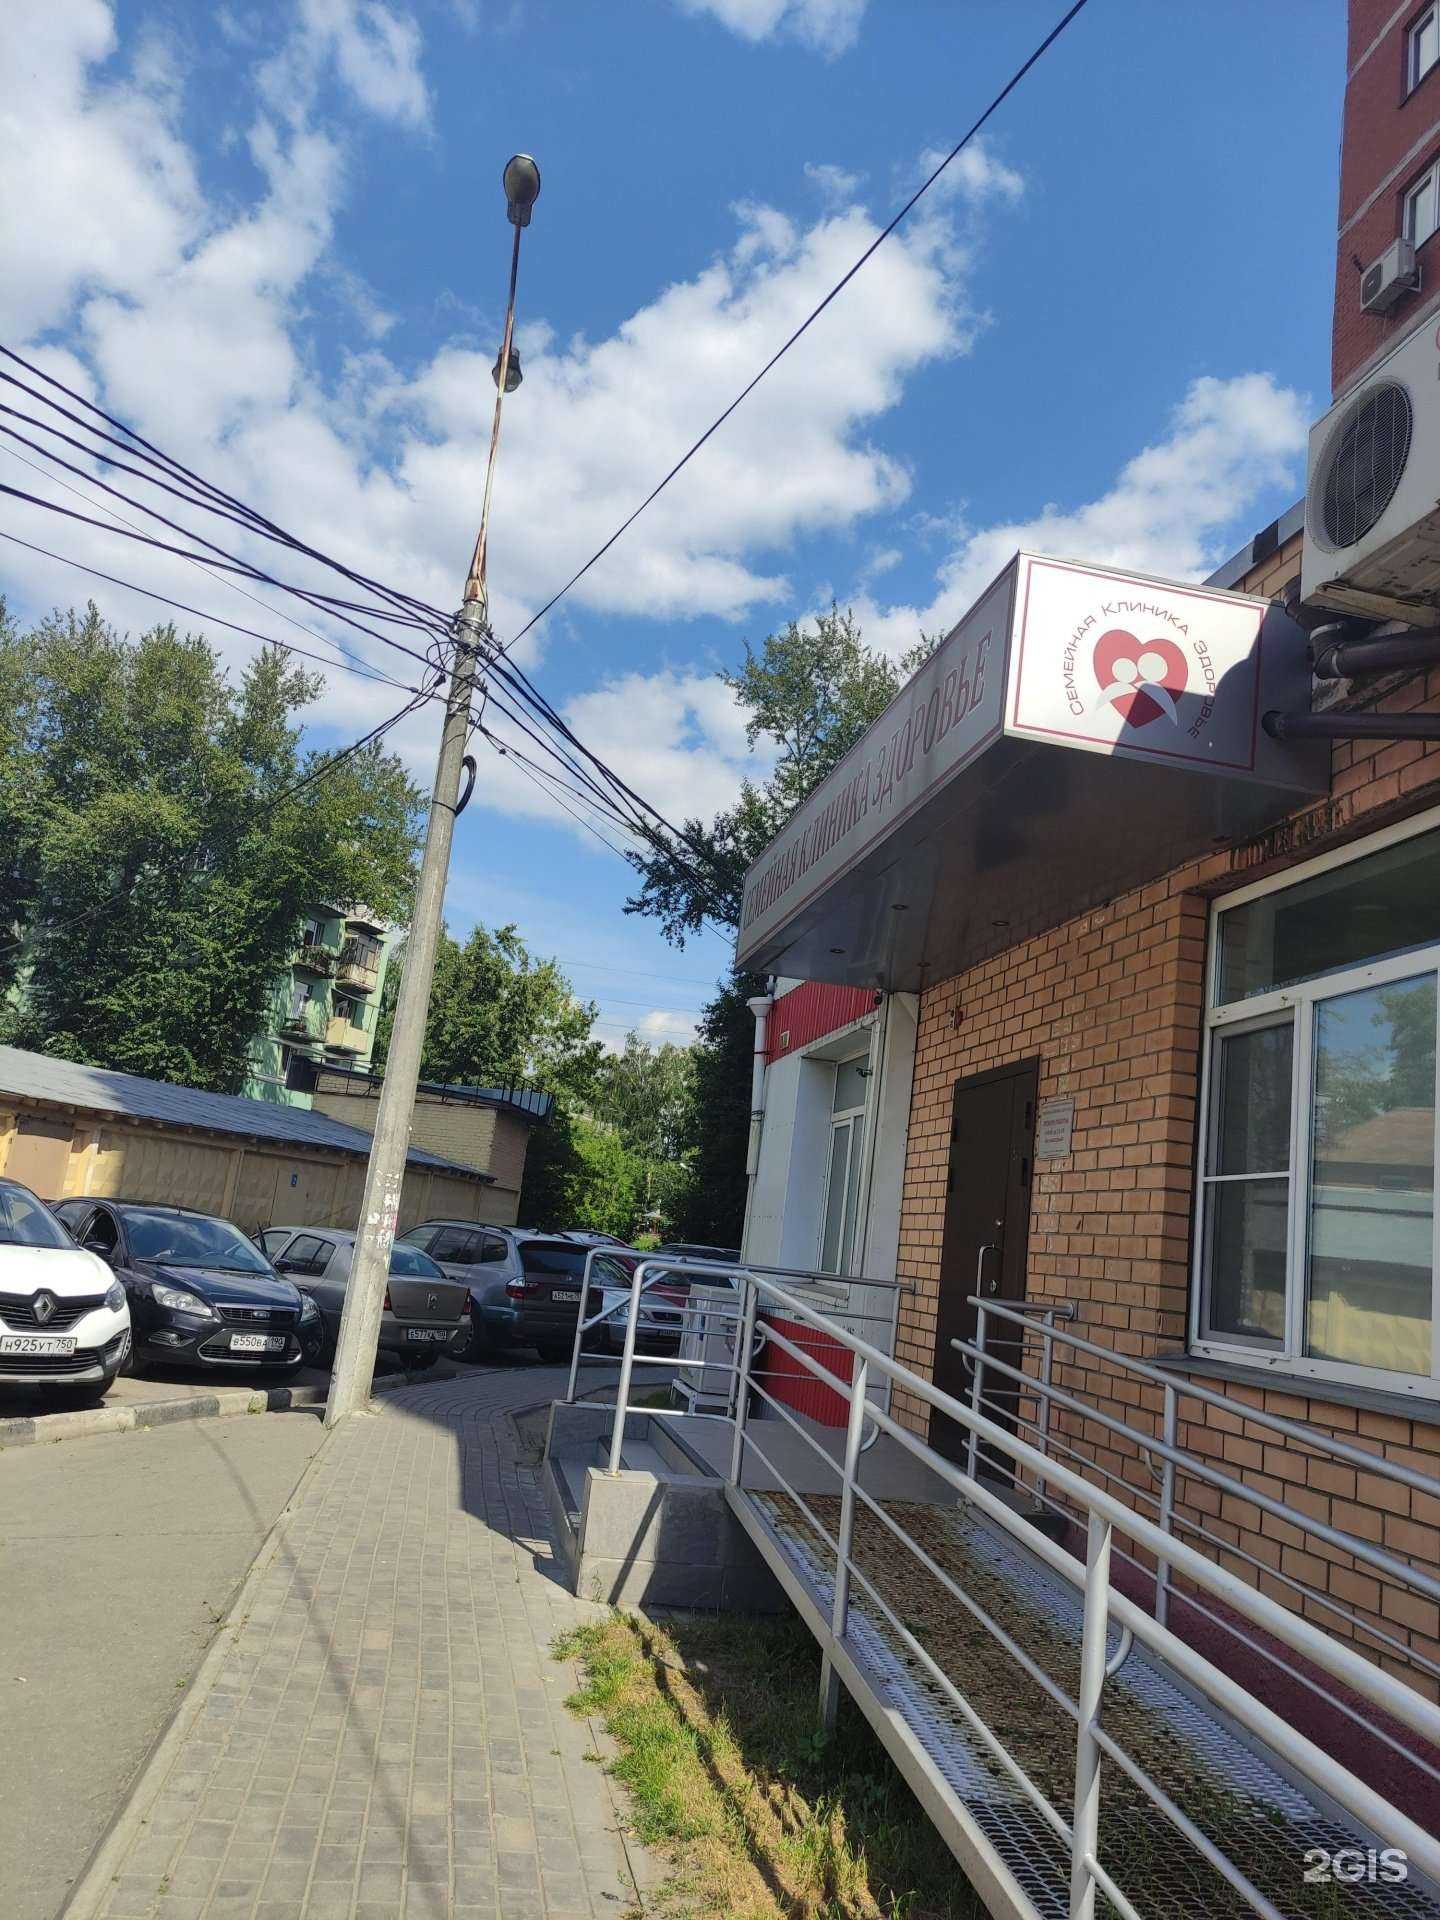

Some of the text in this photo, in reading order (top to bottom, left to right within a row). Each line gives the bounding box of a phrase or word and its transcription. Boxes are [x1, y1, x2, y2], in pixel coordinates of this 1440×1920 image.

[1063, 600, 1216, 739] СЕМЕЙНАЯ КЛИНИКА ЗДОРОВЬЕ
[799, 762, 870, 876] КЛИНИКА
[871, 630, 992, 813] ЗДОРОВЬЕ
[5, 1339, 72, 1351] Н925УТ 750
